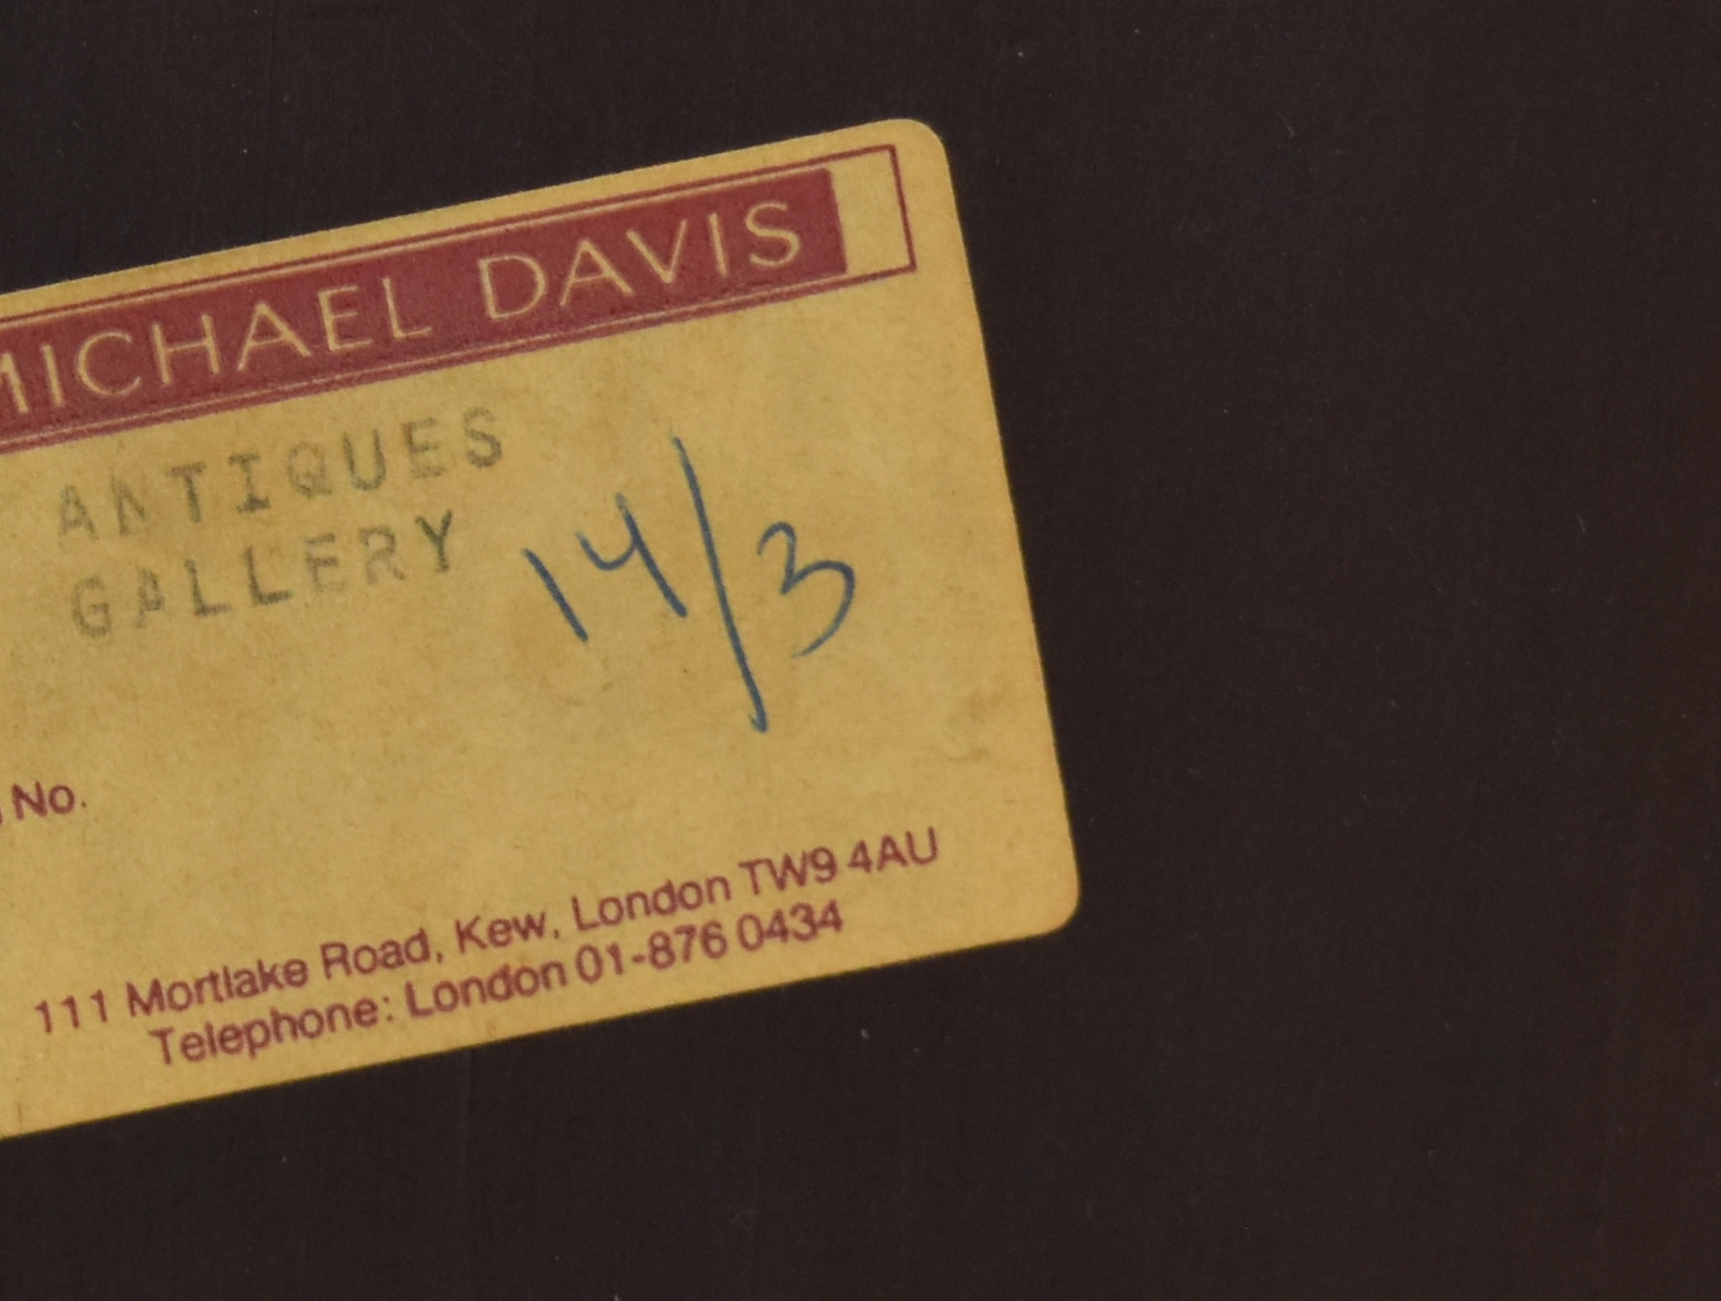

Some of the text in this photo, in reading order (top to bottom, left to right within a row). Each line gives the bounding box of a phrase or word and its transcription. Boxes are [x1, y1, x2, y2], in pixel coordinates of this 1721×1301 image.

[477, 201, 801, 320] DAVIS
[60, 408, 502, 536] ANTIQUES
[72, 509, 455, 638] GALLERY
[10, 781, 87, 820] No.
[35, 989, 108, 1033] 111
[125, 958, 309, 1017] Mortlake
[319, 927, 443, 980] Road,
[570, 875, 732, 932] London
[737, 846, 838, 895] TW9
[847, 827, 938, 873] 4AU
[148, 899, 843, 1065] Telephone: London 01-876 0434
